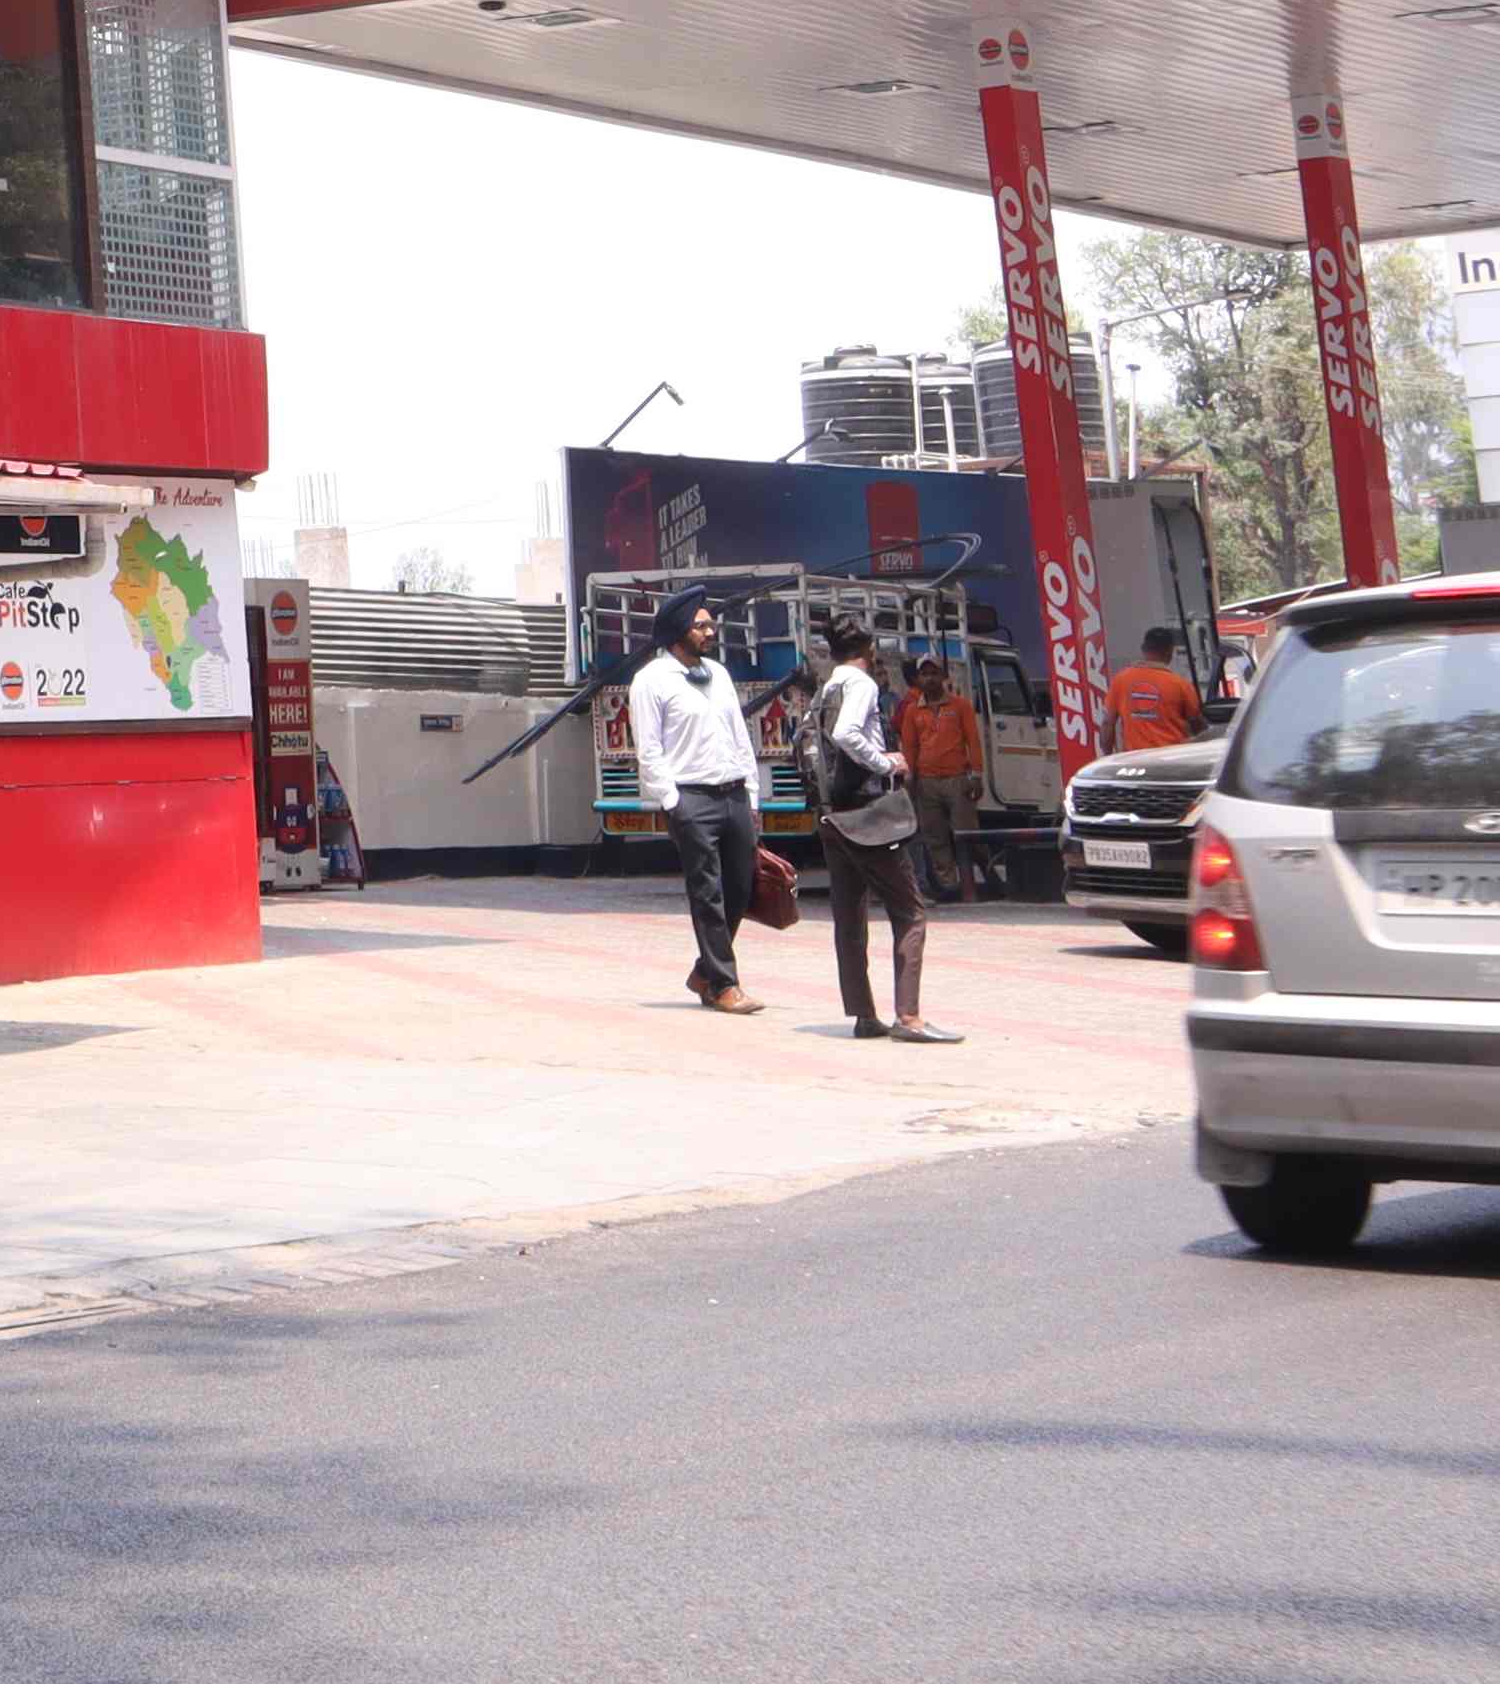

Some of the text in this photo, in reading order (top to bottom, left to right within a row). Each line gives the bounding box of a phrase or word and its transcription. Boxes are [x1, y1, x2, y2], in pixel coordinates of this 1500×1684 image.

[999, 186, 1041, 375] SERVO
[1027, 166, 1072, 401] SERVO
[1315, 247, 1354, 417] SERVO
[1341, 225, 1380, 436] SERVO
[658, 484, 701, 528] IT TAKES
[670, 506, 707, 547] LEADER
[36, 668, 85, 696] 2022
[269, 704, 308, 725] HERE!
[1043, 562, 1087, 746] SERVO
